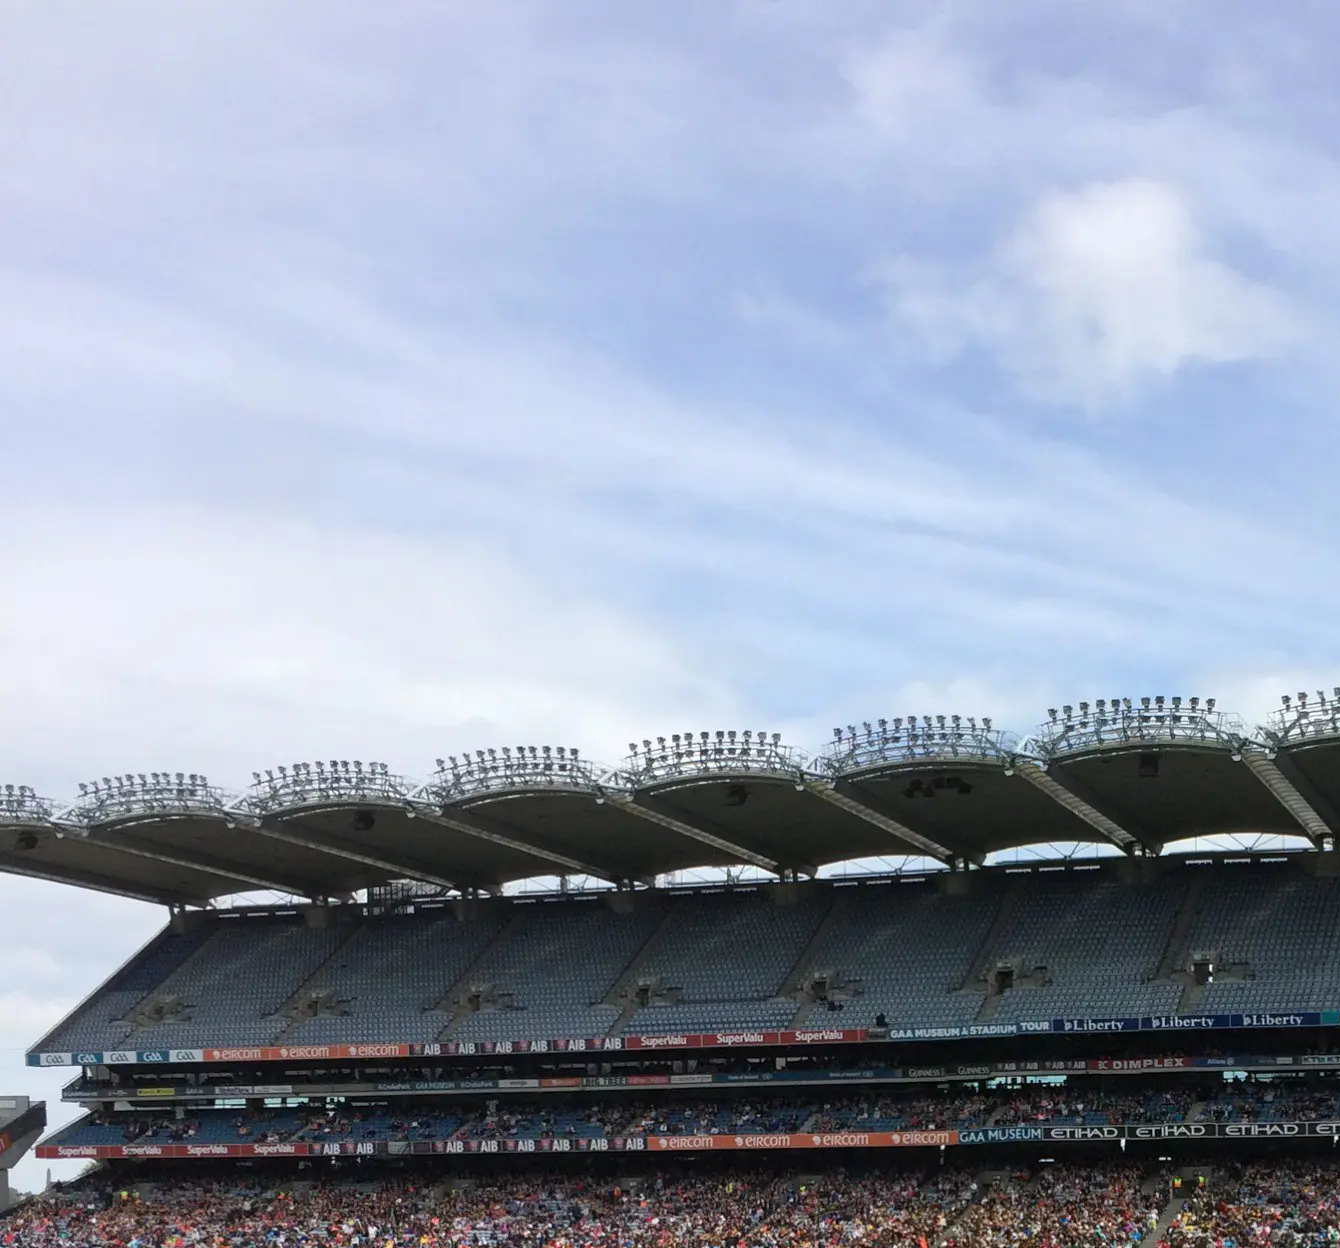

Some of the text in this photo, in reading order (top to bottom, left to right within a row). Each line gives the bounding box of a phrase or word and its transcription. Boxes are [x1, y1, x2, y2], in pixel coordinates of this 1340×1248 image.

[1073, 1019, 1124, 1031] Liberty
[1161, 1016, 1214, 1028] Liberty
[1253, 1013, 1304, 1026] Liberty
[891, 1029, 914, 1039] GAA
[915, 1027, 960, 1038] MUSEUM
[970, 1024, 1017, 1035] STADIUM
[1020, 1021, 1050, 1031] TOUR
[641, 1036, 687, 1048] SuperValu
[716, 1033, 763, 1046] SuperValu
[795, 1030, 844, 1043] SuperValu
[424, 1043, 441, 1055] AIB
[458, 1042, 476, 1054] AIB
[495, 1042, 513, 1053] AIB
[530, 1041, 548, 1052] AIB
[568, 1039, 586, 1051] AIB
[604, 1038, 622, 1050] AIB
[1112, 1057, 1184, 1070] DIMPLEX
[959, 1128, 1041, 1142] GAA MUSEUM
[1050, 1128, 1118, 1139] ETIHAD
[1136, 1125, 1206, 1137] ETIHAD
[1225, 1124, 1299, 1136] ETIHAD
[253, 1143, 295, 1155] SuperValu
[323, 1143, 341, 1155] AIB
[356, 1142, 374, 1154] AIB
[446, 1141, 464, 1152] AIB
[480, 1141, 498, 1152] AIB
[517, 1140, 535, 1151] AIB
[552, 1139, 570, 1151] AIB
[590, 1138, 608, 1150] AIB
[625, 1137, 644, 1149] AIB
[57, 1146, 97, 1157] SuperValu
[187, 1145, 228, 1156] SuperValu
